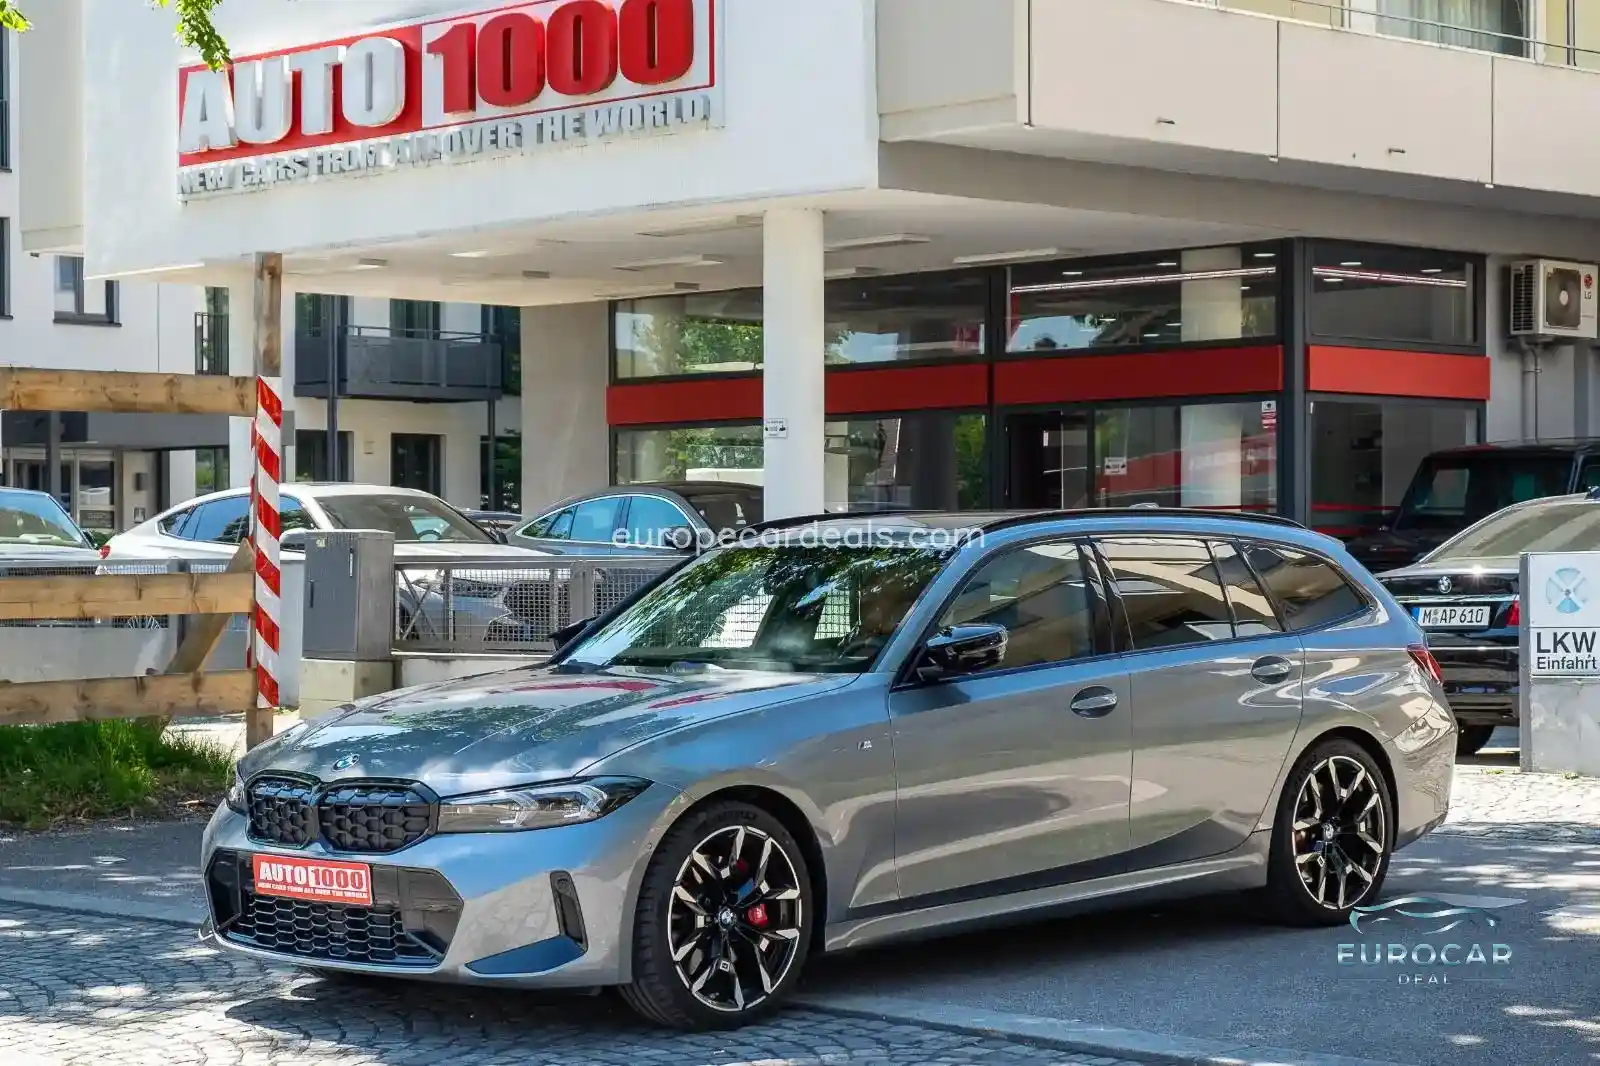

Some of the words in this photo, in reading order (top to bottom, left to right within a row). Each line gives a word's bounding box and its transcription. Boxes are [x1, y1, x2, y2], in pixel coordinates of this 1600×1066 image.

[179, 36, 407, 155] AUTO
[425, 0, 695, 115] 1000
[177, 163, 231, 194] NEW
[236, 155, 308, 187] CARS
[309, 140, 389, 177] FROM
[443, 120, 523, 159] OVER
[525, 111, 586, 146] THE
[1584, 291, 1592, 300] LG
[1459, 608, 1484, 624] 610
[1536, 631, 1597, 654] LKW
[1537, 656, 1597, 670] Einfahrt
[260, 861, 307, 885] AUTO
[311, 867, 364, 890] 1000
